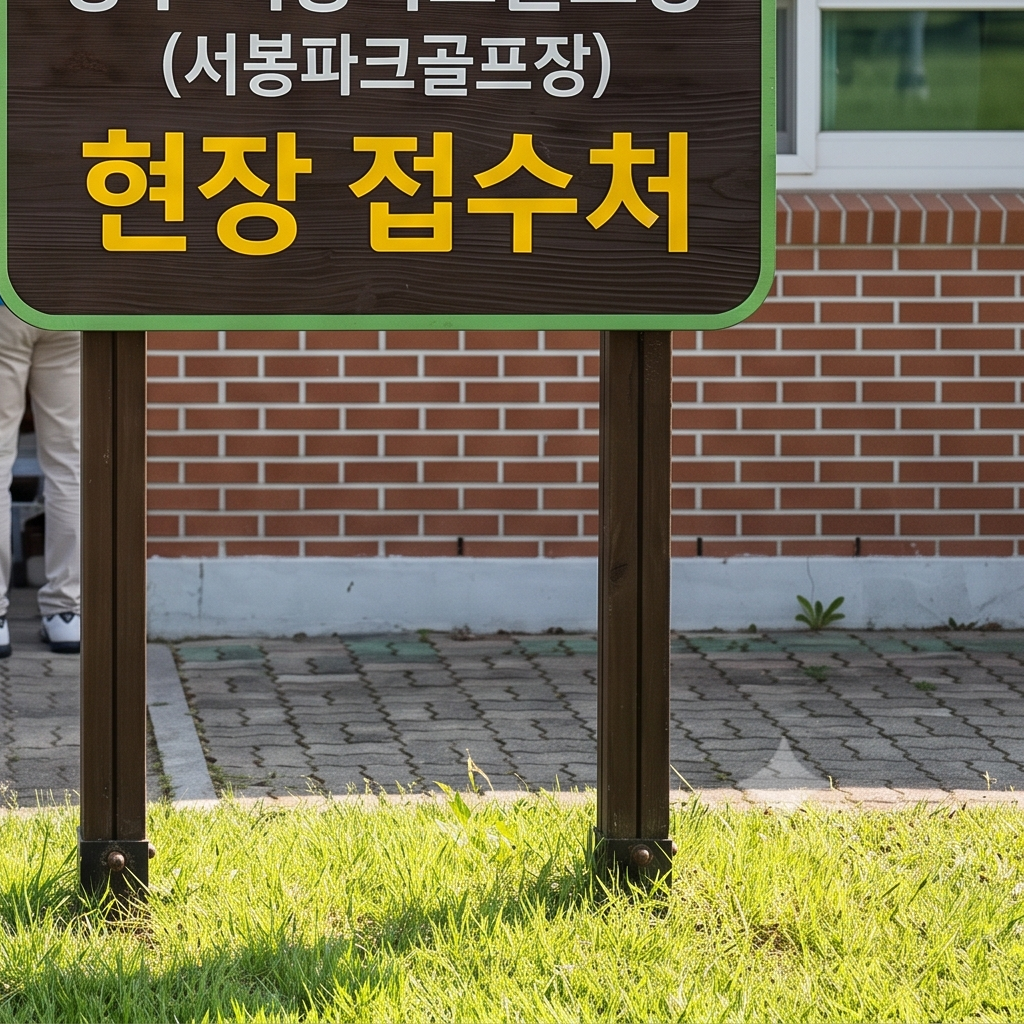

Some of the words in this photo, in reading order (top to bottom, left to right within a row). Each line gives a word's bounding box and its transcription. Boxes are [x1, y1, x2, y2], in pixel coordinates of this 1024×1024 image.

[161, 31, 612, 100] (서봉파크골프장)
[81, 128, 313, 257] 현장
[348, 130, 690, 255] 접수처
